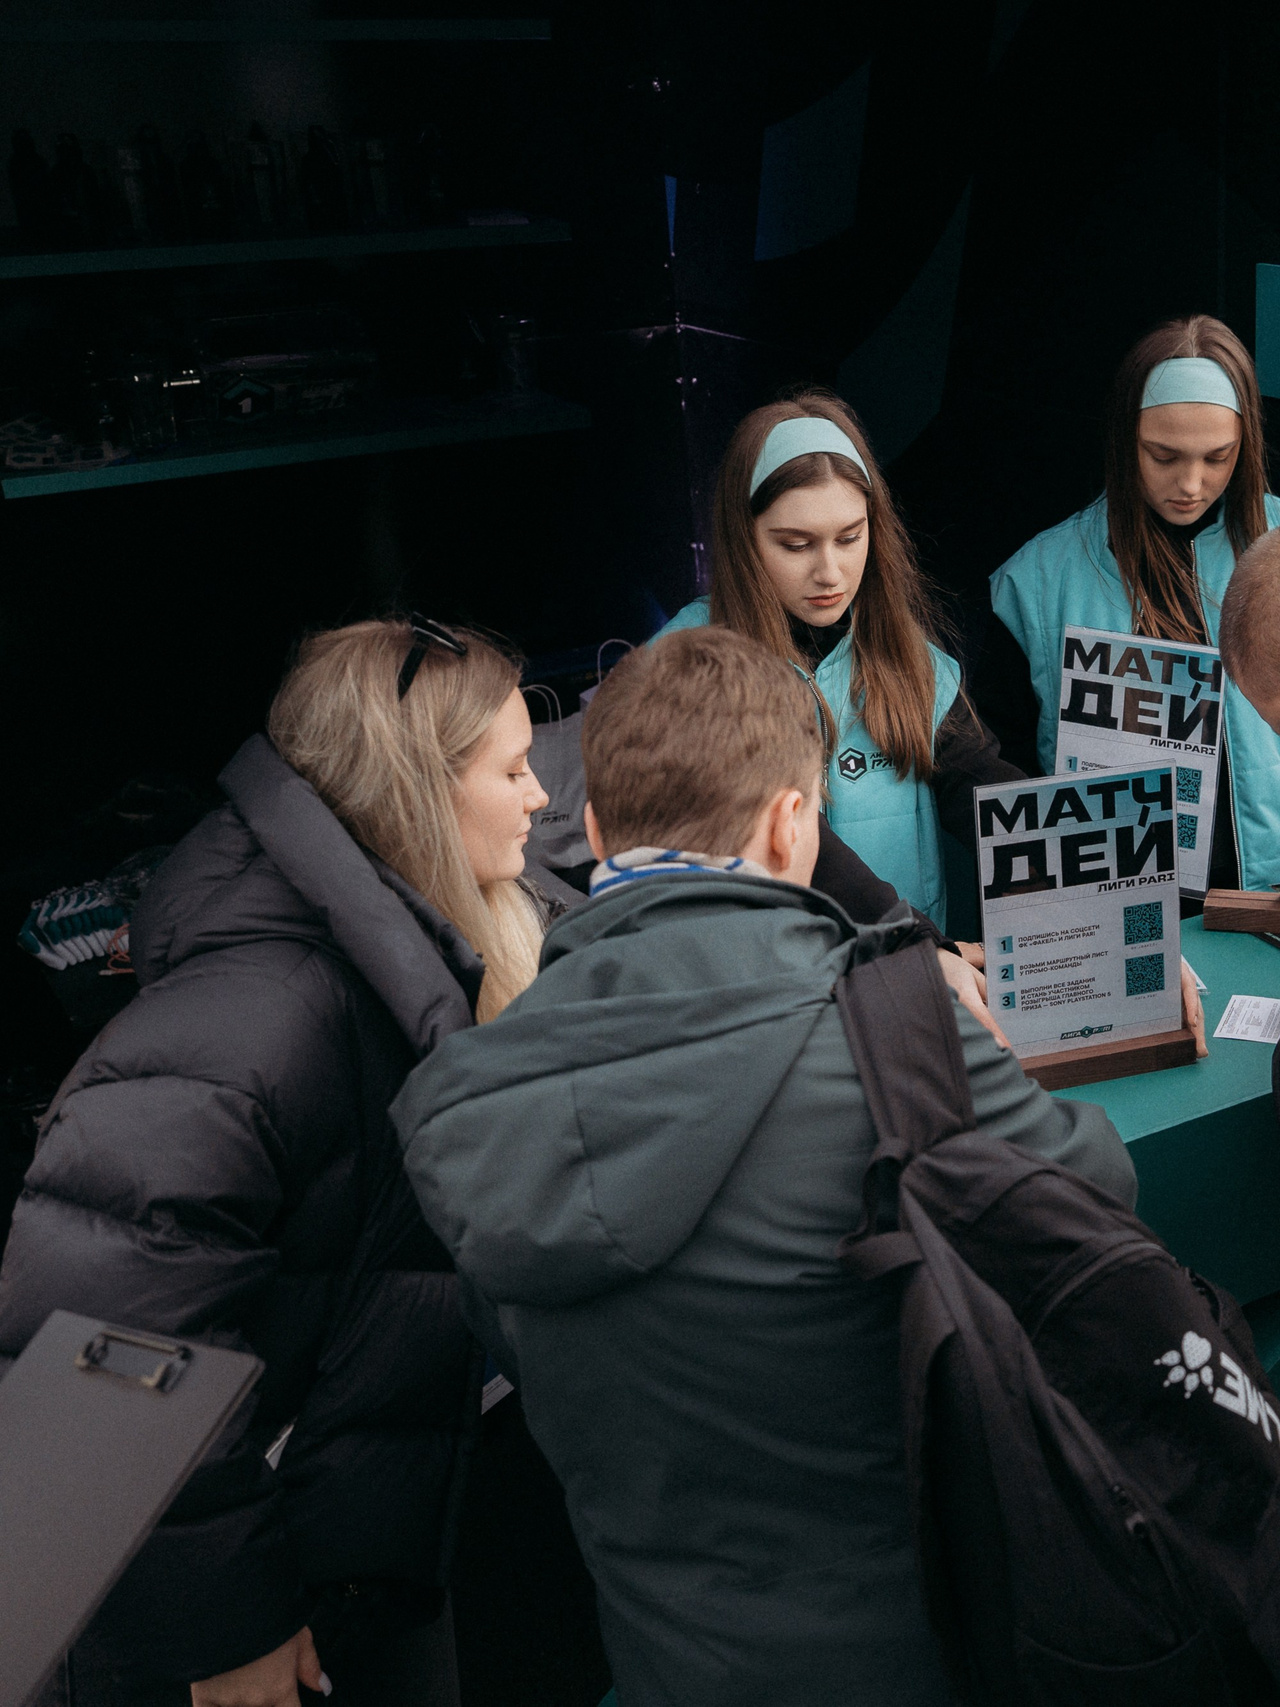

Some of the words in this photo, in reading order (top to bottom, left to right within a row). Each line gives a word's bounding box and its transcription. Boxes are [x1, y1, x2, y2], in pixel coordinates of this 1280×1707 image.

[1063, 637, 1222, 693] МАТЧ
[1061, 682, 1219, 746] ДЕЙ
[1150, 738, 1182, 750] ЛИГИ
[1184, 744, 1216, 756] PARI
[847, 759, 855, 769] 1
[1068, 759, 1072, 768] 1
[979, 773, 1172, 838] МАТЧ
[984, 804, 1175, 900] ДЕЙ
[1098, 879, 1136, 893] ЛИГИ
[1138, 872, 1176, 886] PARI
[1018, 931, 1060, 942] ПОДПИШИСЬ
[1070, 924, 1100, 934] СОЦСЕТИ
[1000, 940, 1006, 950] 1
[1029, 938, 1057, 946] «ФАКЕЛ»
[1020, 962, 1046, 970] ВОЗЬМИ
[1046, 952, 1090, 966] МАРШРУТНЫЙ
[1092, 950, 1108, 958] ЛИСТ
[1025, 961, 1082, 976] ПРОМО-КОМАНДЫ
[1001, 968, 1010, 980] 2
[1020, 985, 1052, 994] ВЫПОЛНИ
[1067, 977, 1096, 986] ЗАДАНИЯ
[1048, 984, 1090, 996] УЧАСТНИКОМ
[1002, 996, 1010, 1007] 3
[1021, 996, 1060, 1006] РОЗЫГРЫША
[1062, 988, 1094, 998] ГЛАВНОГО
[1022, 1004, 1042, 1012] ПРИЗА
[1067, 993, 1106, 1004] PLAYSTATION
[1092, 1026, 1110, 1034] PRI
